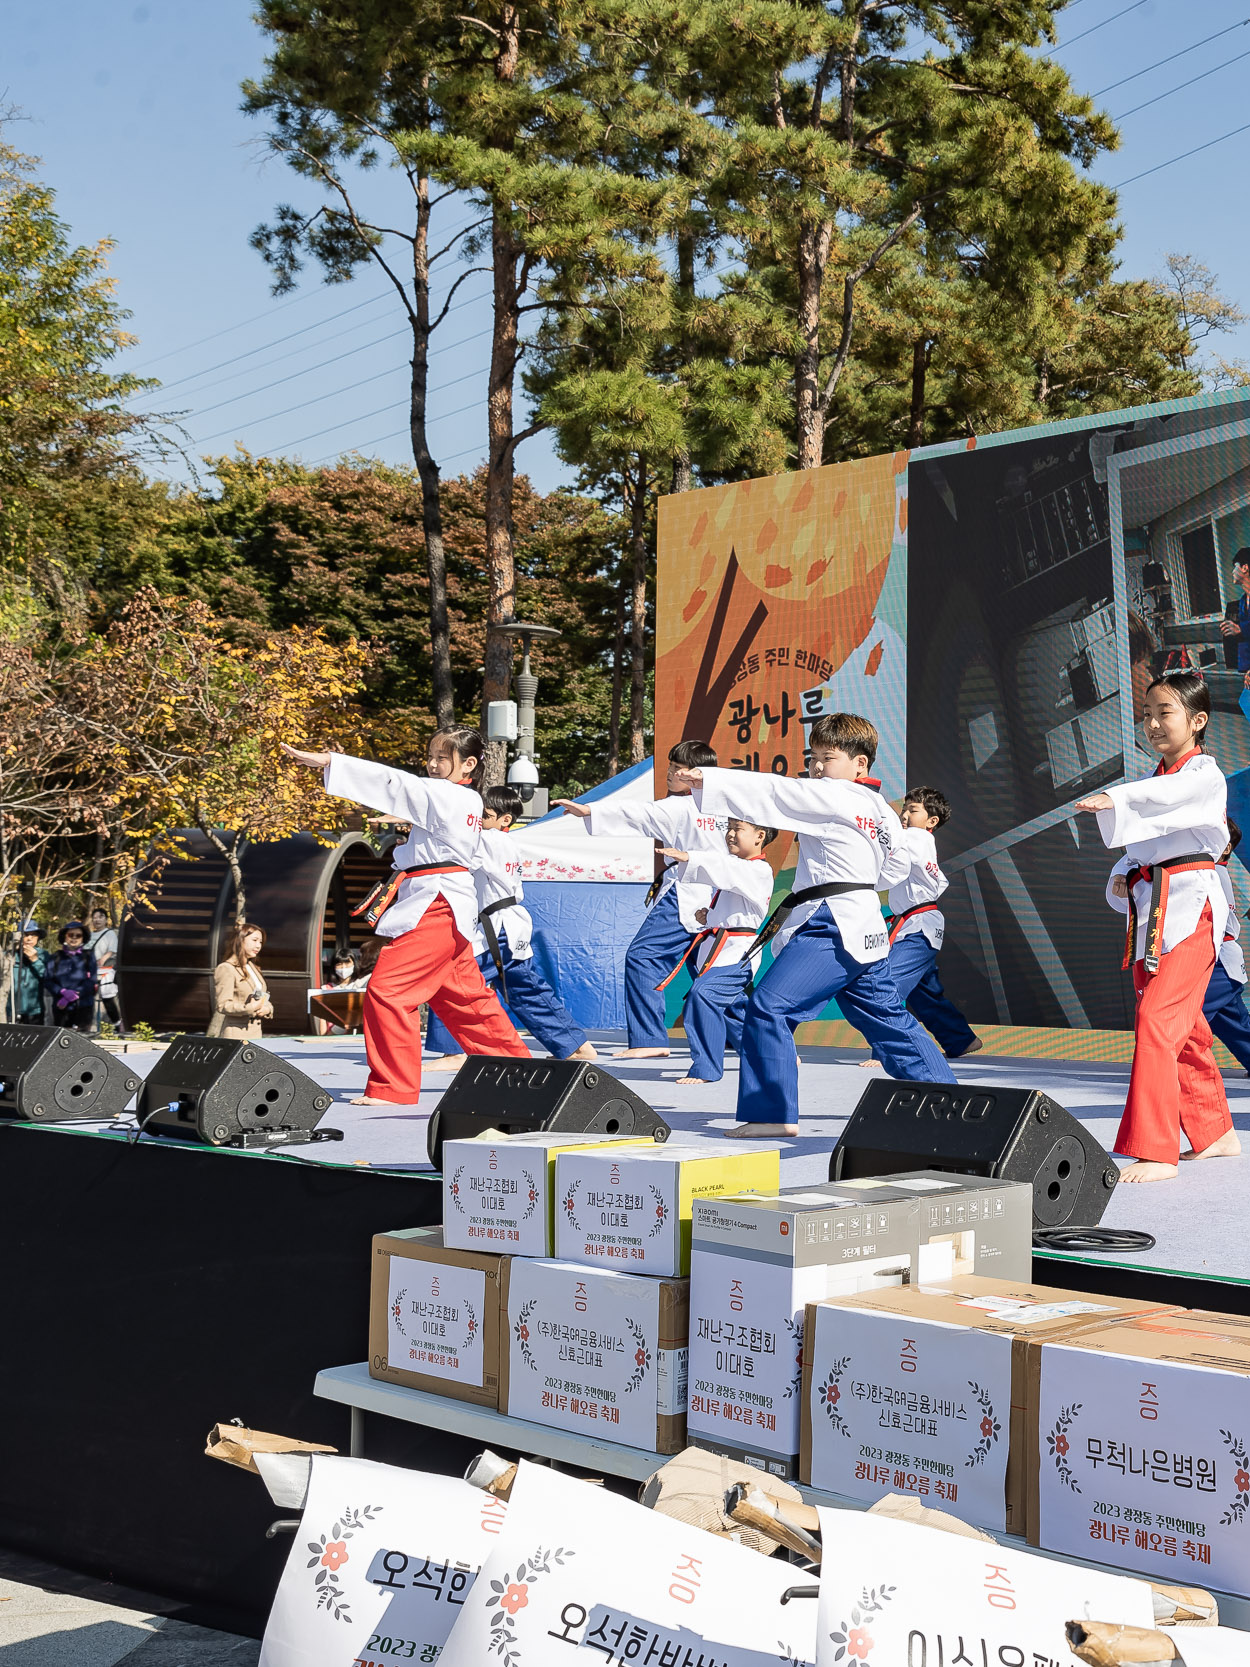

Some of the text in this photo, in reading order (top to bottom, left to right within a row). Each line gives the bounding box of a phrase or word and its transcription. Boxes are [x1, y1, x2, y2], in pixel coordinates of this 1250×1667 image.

[765, 647, 790, 668] 주민
[795, 650, 834, 682] 한마당
[481, 1196, 506, 1212] 이대호
[691, 1185, 709, 1194] BLACK
[709, 1184, 725, 1192] PEARL
[600, 1211, 629, 1228] 이대호
[738, 1222, 758, 1231] Compact
[862, 1244, 877, 1256] 필터
[574, 1282, 588, 1312] 증
[729, 1279, 744, 1312] 증
[422, 1320, 446, 1337] 이대호
[697, 1317, 777, 1355] 재난구조협회
[558, 1344, 603, 1368] 신효근대표
[716, 1350, 755, 1378] 이대호
[900, 1338, 918, 1373] 증
[544, 1376, 617, 1403] 2023 광장동 주민한마당
[694, 1378, 774, 1409] 2023 광장동 주민한마당
[1139, 1382, 1159, 1421] 증
[541, 1390, 620, 1424] 광나루 해오름 축제
[691, 1394, 776, 1432] 광나루 해오름 축제
[878, 1408, 938, 1437] 신효근대표
[859, 1444, 954, 1478] 2023 광장동 주민한마당
[1085, 1437, 1217, 1493] 무척나은병원
[854, 1460, 958, 1503] 광나루 해오름 축제
[1093, 1500, 1206, 1537] 2023 광장동 주민한마당
[1088, 1518, 1211, 1565] 광나루 해오름 축제
[668, 1553, 703, 1605] 증
[983, 1563, 1017, 1610] 증
[366, 1634, 417, 1658] 2023
